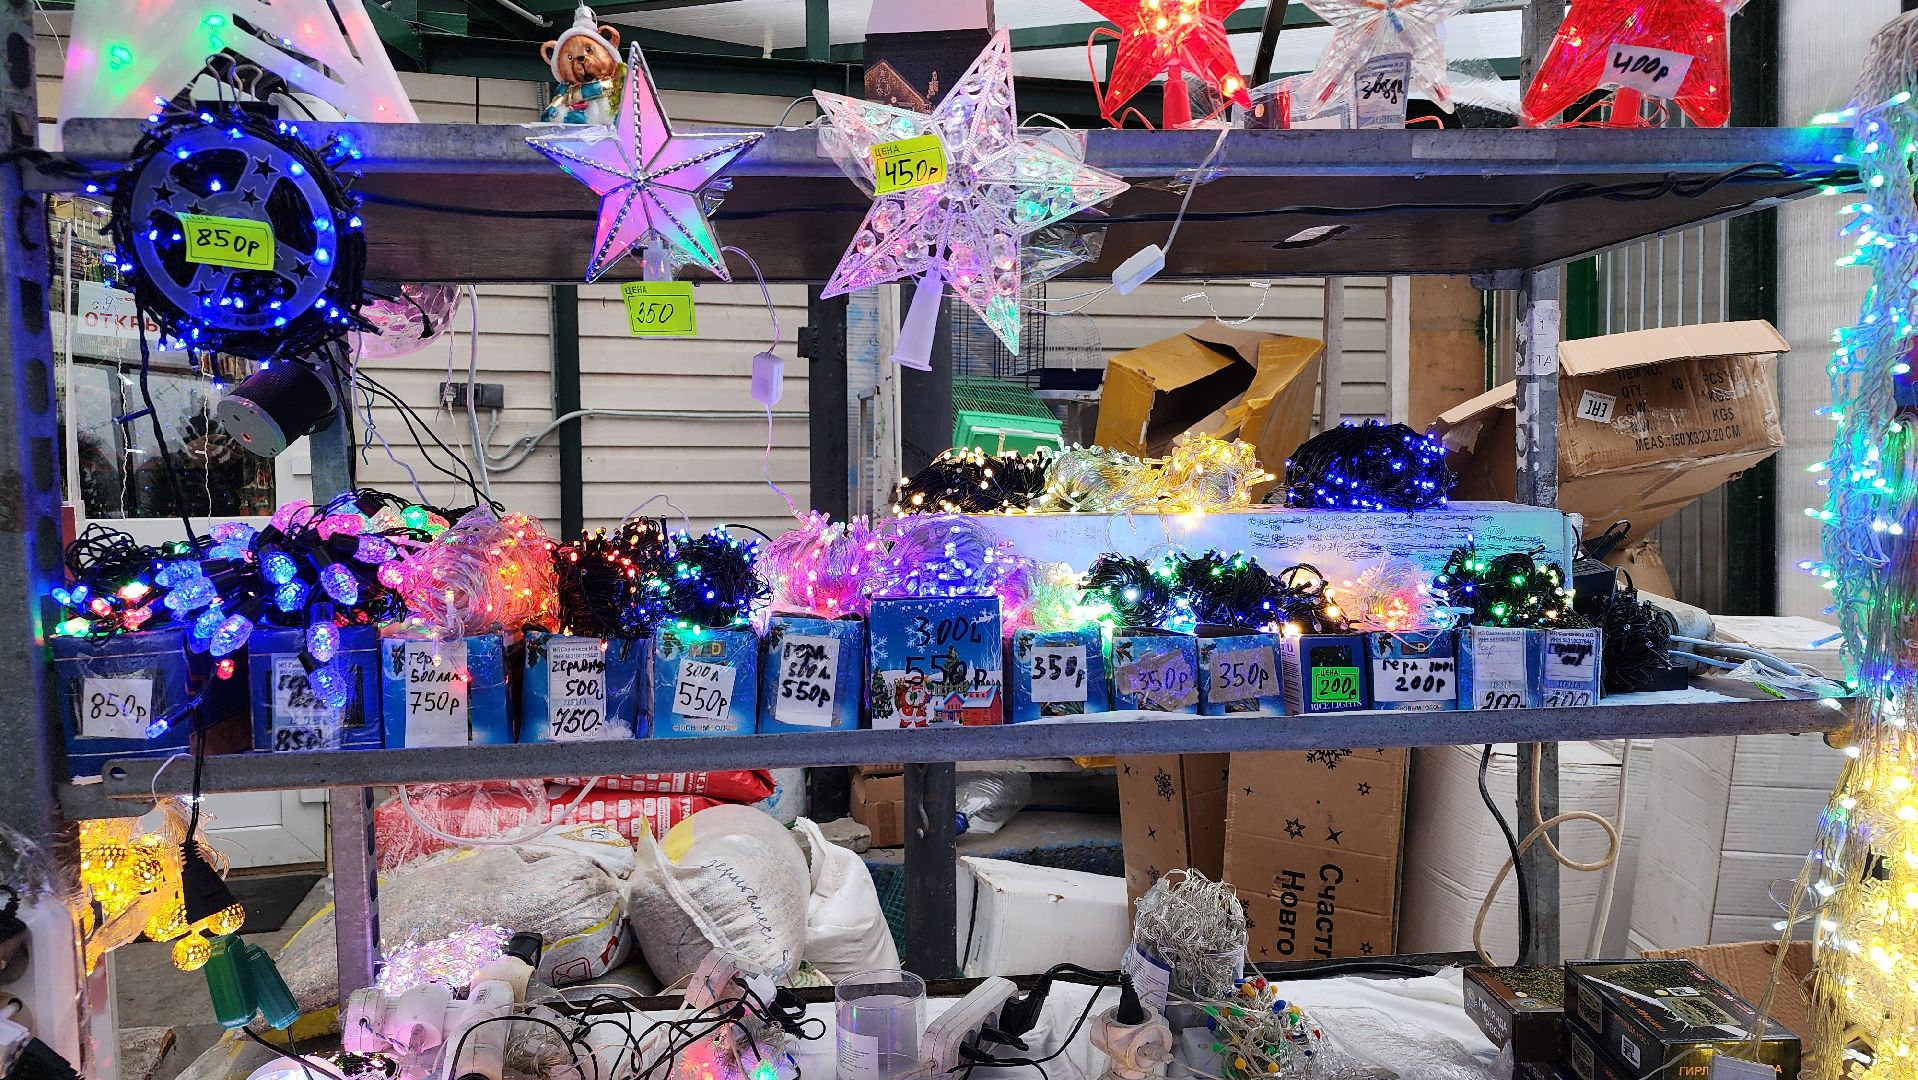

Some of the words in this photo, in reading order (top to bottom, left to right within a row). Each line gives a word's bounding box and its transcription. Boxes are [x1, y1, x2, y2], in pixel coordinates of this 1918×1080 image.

[1613, 52, 1669, 82] 400р
[874, 144, 900, 156] ЦЕНА
[884, 158, 938, 186] 450р
[197, 228, 260, 257] 850р
[624, 285, 647, 295] ЦЕНА
[636, 301, 674, 324] 350
[1712, 407, 1736, 423] KGS
[905, 654, 988, 692] 550р
[1031, 653, 1085, 688] 350р
[1137, 667, 1189, 692] 350р
[1219, 662, 1270, 689] 350р
[1394, 674, 1446, 694] 200р
[679, 681, 728, 716] 550р
[781, 678, 831, 708] 550р
[1319, 676, 1357, 700] 200р
[91, 692, 147, 723] 850р
[409, 691, 460, 716] 750р
